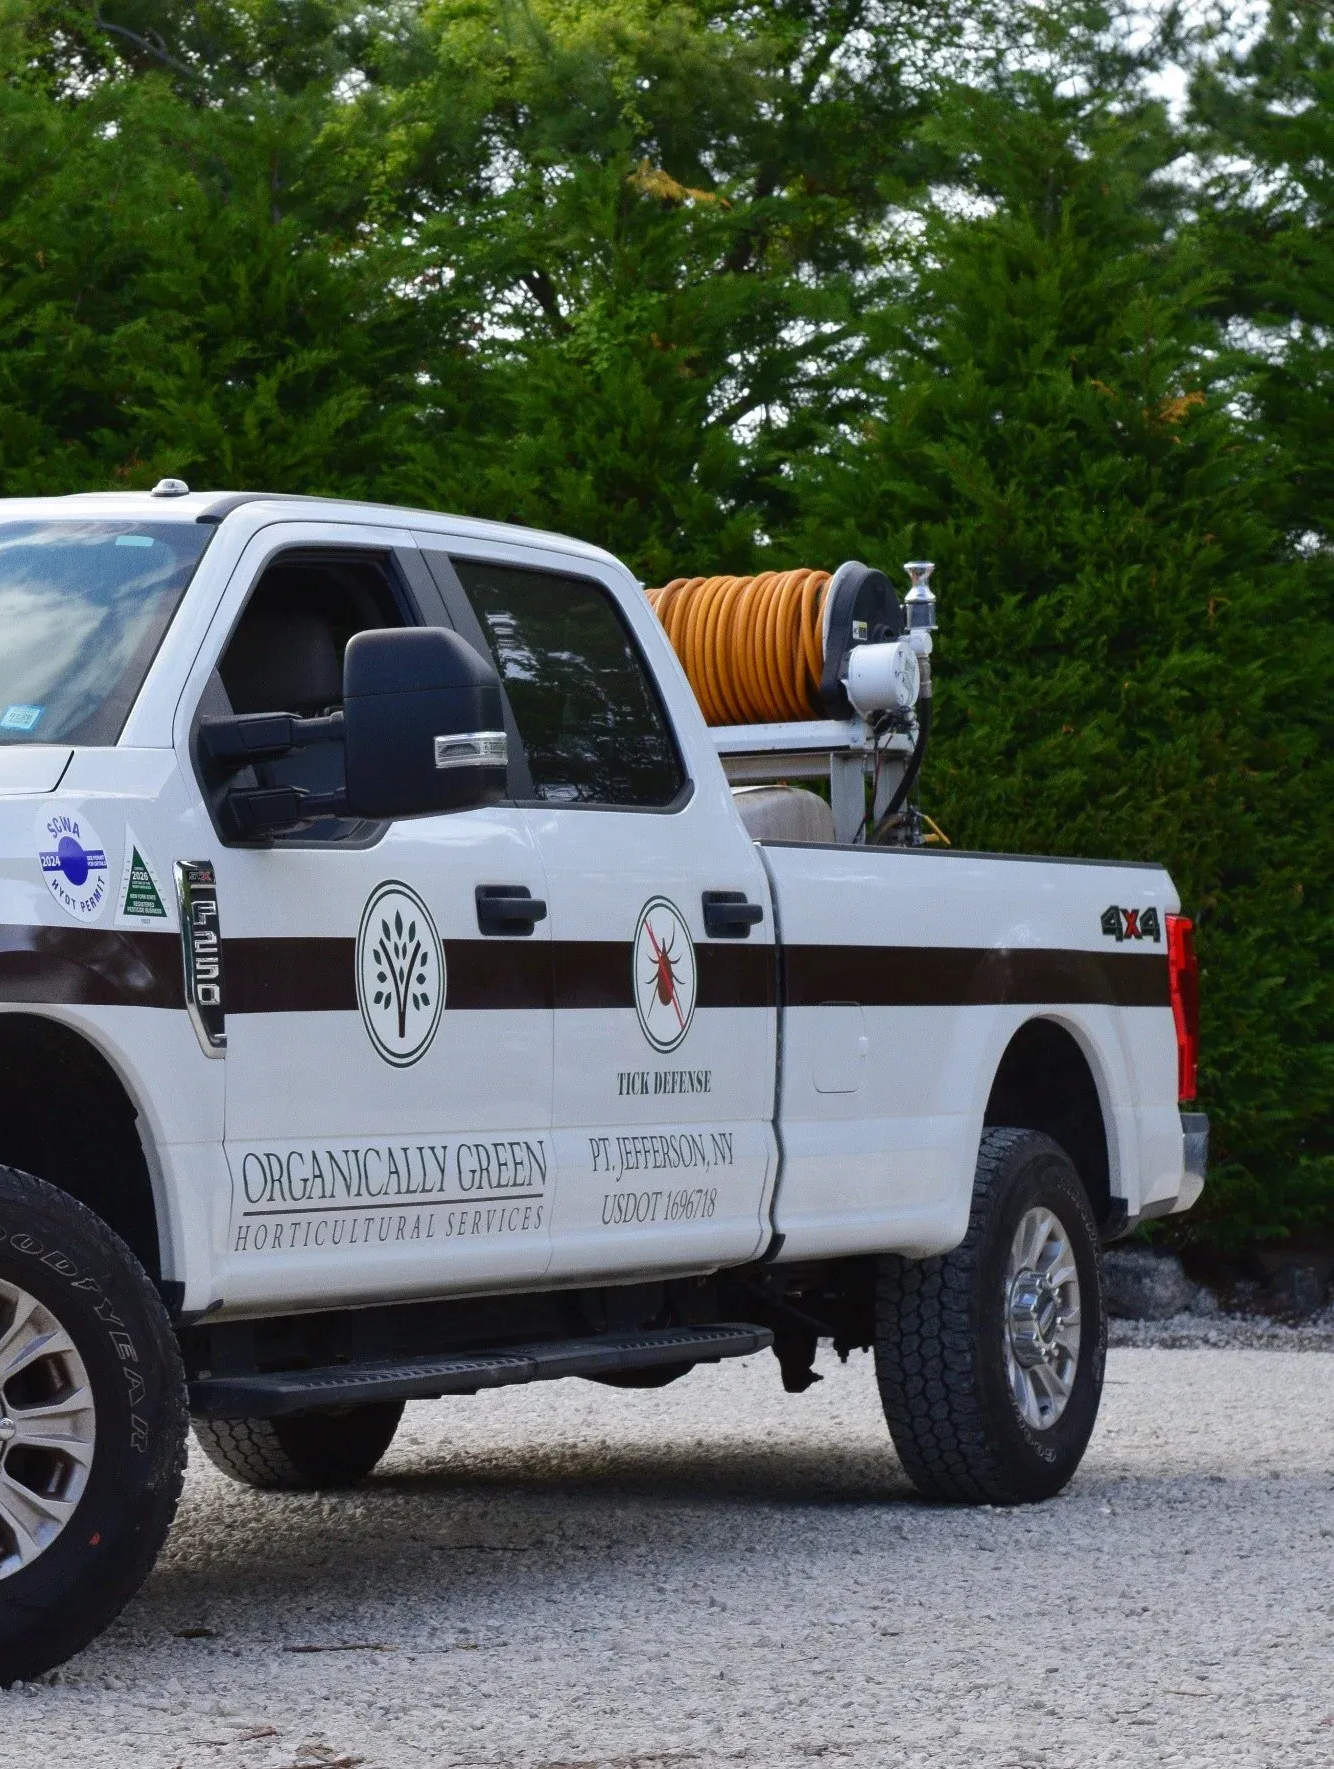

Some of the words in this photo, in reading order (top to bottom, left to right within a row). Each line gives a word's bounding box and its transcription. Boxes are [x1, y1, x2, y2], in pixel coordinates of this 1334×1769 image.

[47, 816, 81, 838] SCWA
[41, 856, 61, 867] 2024
[51, 879, 76, 910] HYDT
[80, 875, 106, 912] PERMIT
[190, 900, 221, 1006] F250
[617, 1071, 650, 1096] TICK
[654, 1070, 712, 1094] DEFENSE
[242, 1145, 448, 1204] ORGANICALLY
[456, 1140, 547, 1192] GREEN
[589, 1137, 615, 1172] PT.
[615, 1133, 710, 1182] JEFFERSON,
[710, 1132, 734, 1166] NY
[601, 1191, 662, 1225] USDOT
[664, 1187, 717, 1220] 1696718
[234, 1213, 435, 1251] HORTICULTURAL
[445, 1204, 544, 1237] SERVICES
